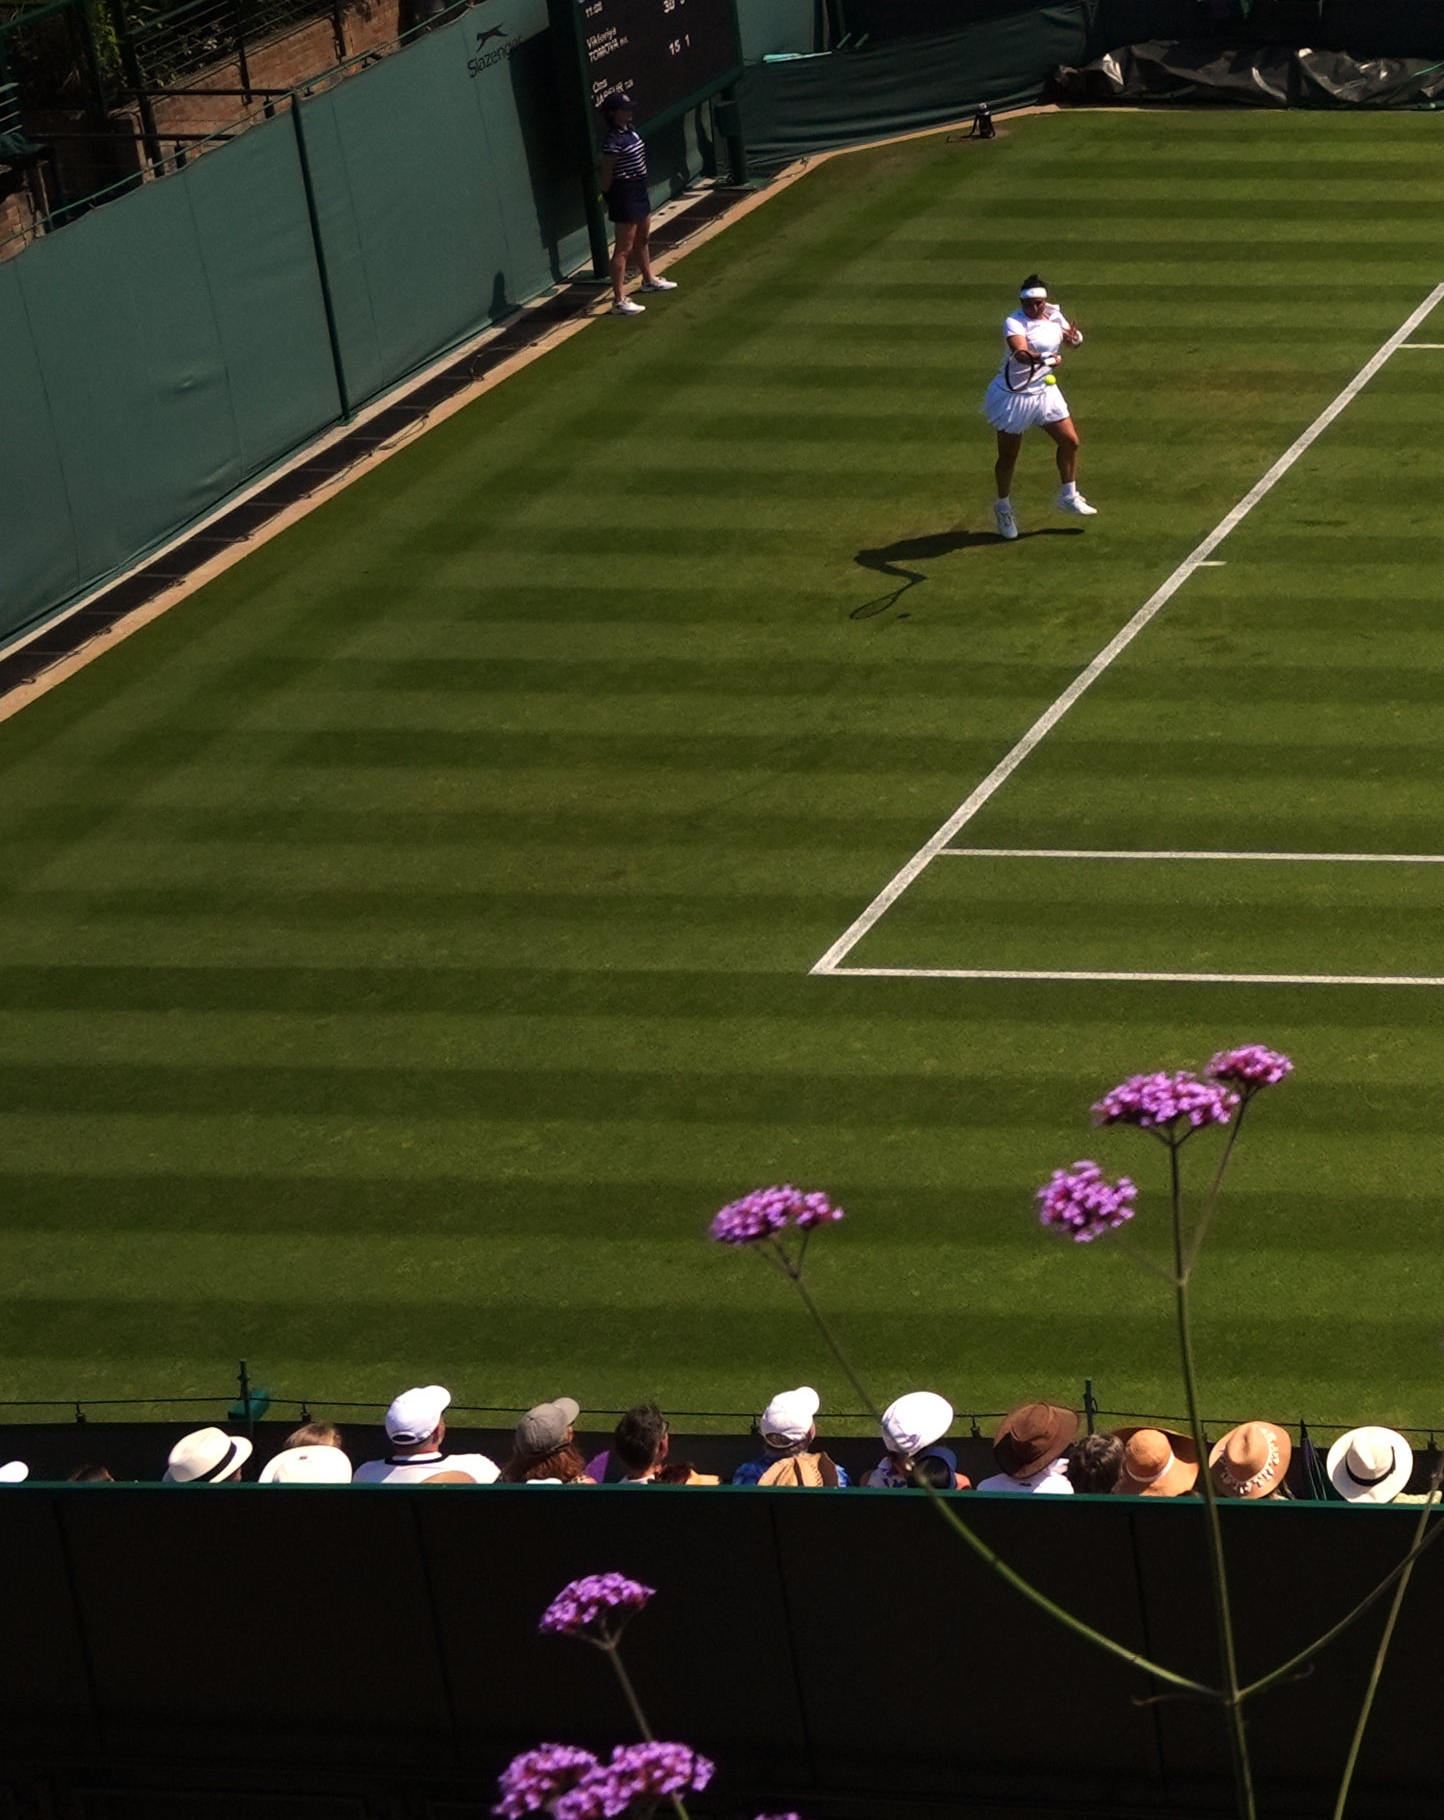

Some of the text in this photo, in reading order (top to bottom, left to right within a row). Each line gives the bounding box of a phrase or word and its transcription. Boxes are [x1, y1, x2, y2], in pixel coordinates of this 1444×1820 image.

[467, 35, 523, 78] Slazenger
[668, 34, 692, 56] 15 1
